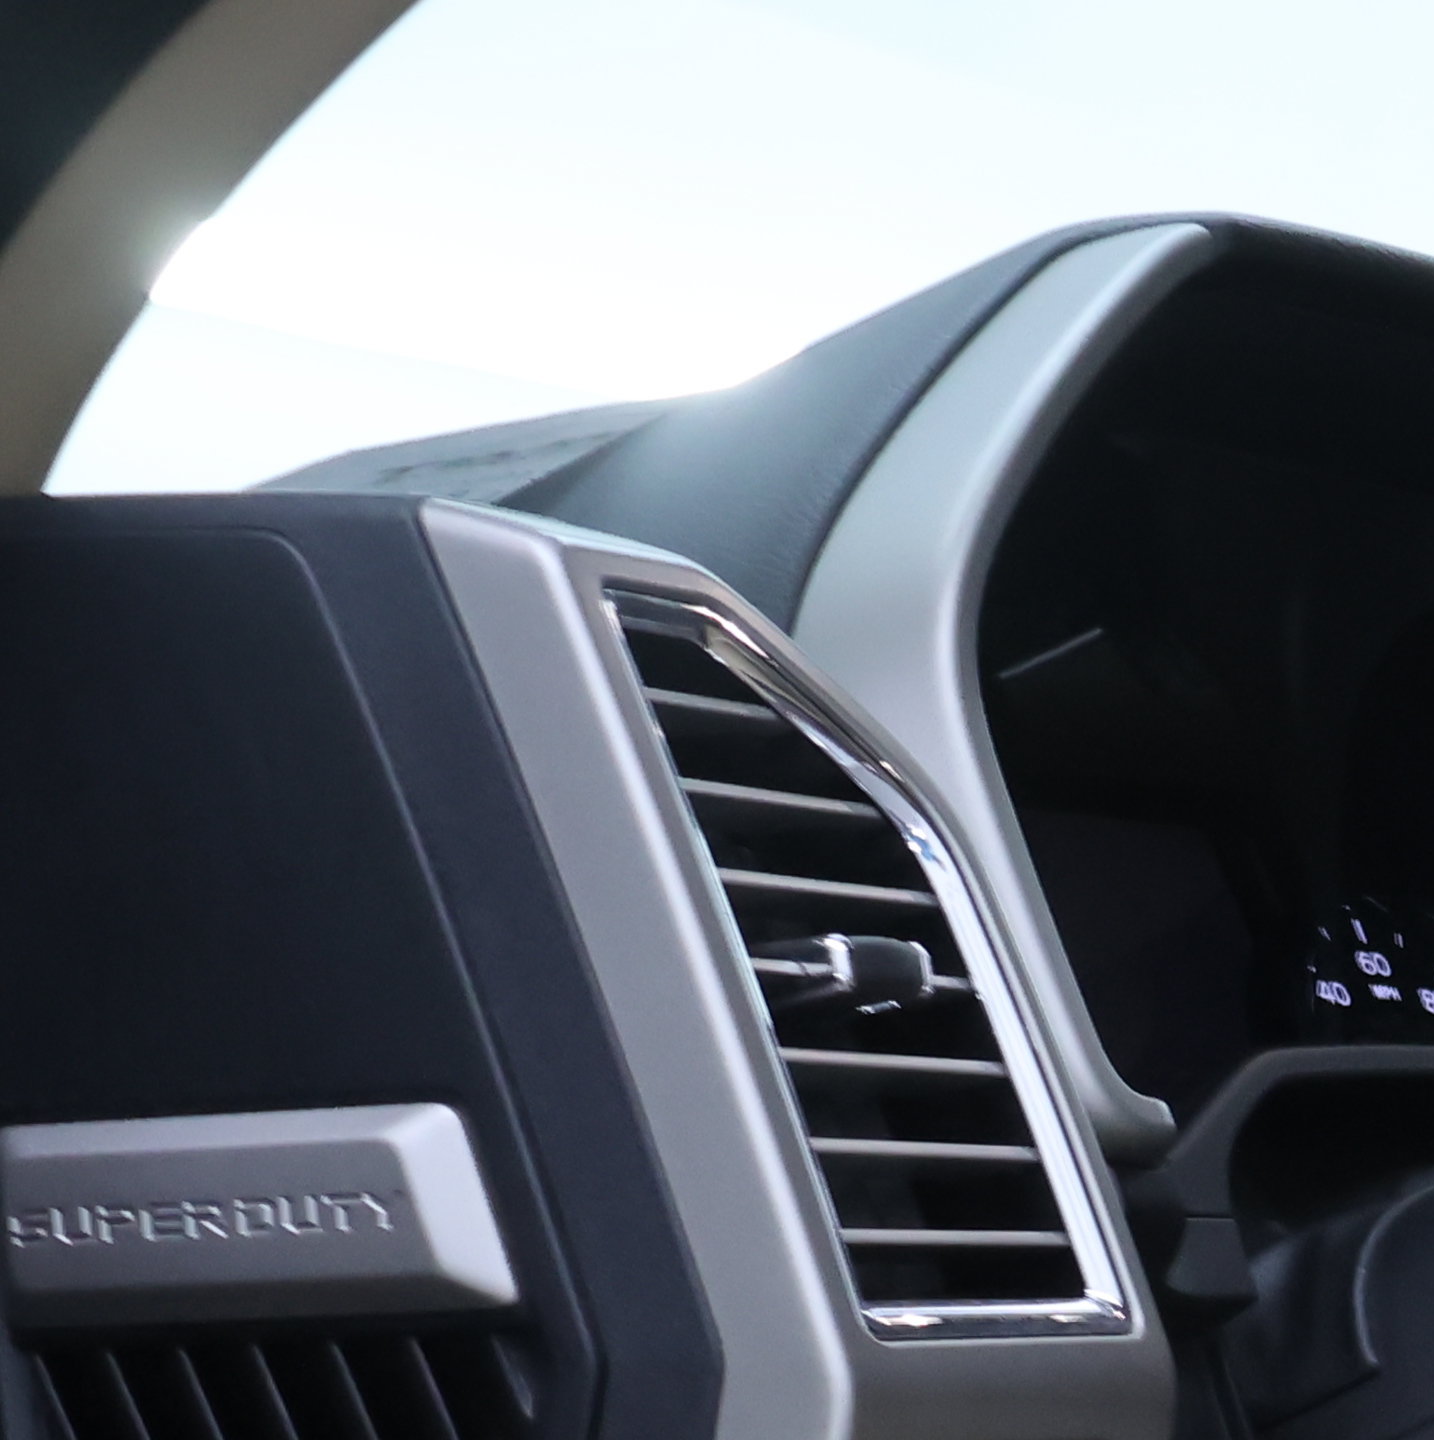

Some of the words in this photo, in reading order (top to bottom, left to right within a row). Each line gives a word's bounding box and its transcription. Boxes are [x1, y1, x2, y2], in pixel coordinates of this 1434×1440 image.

[1354, 950, 1392, 977] 60
[1315, 980, 1352, 1007] 40
[1368, 983, 1402, 1002] MPH
